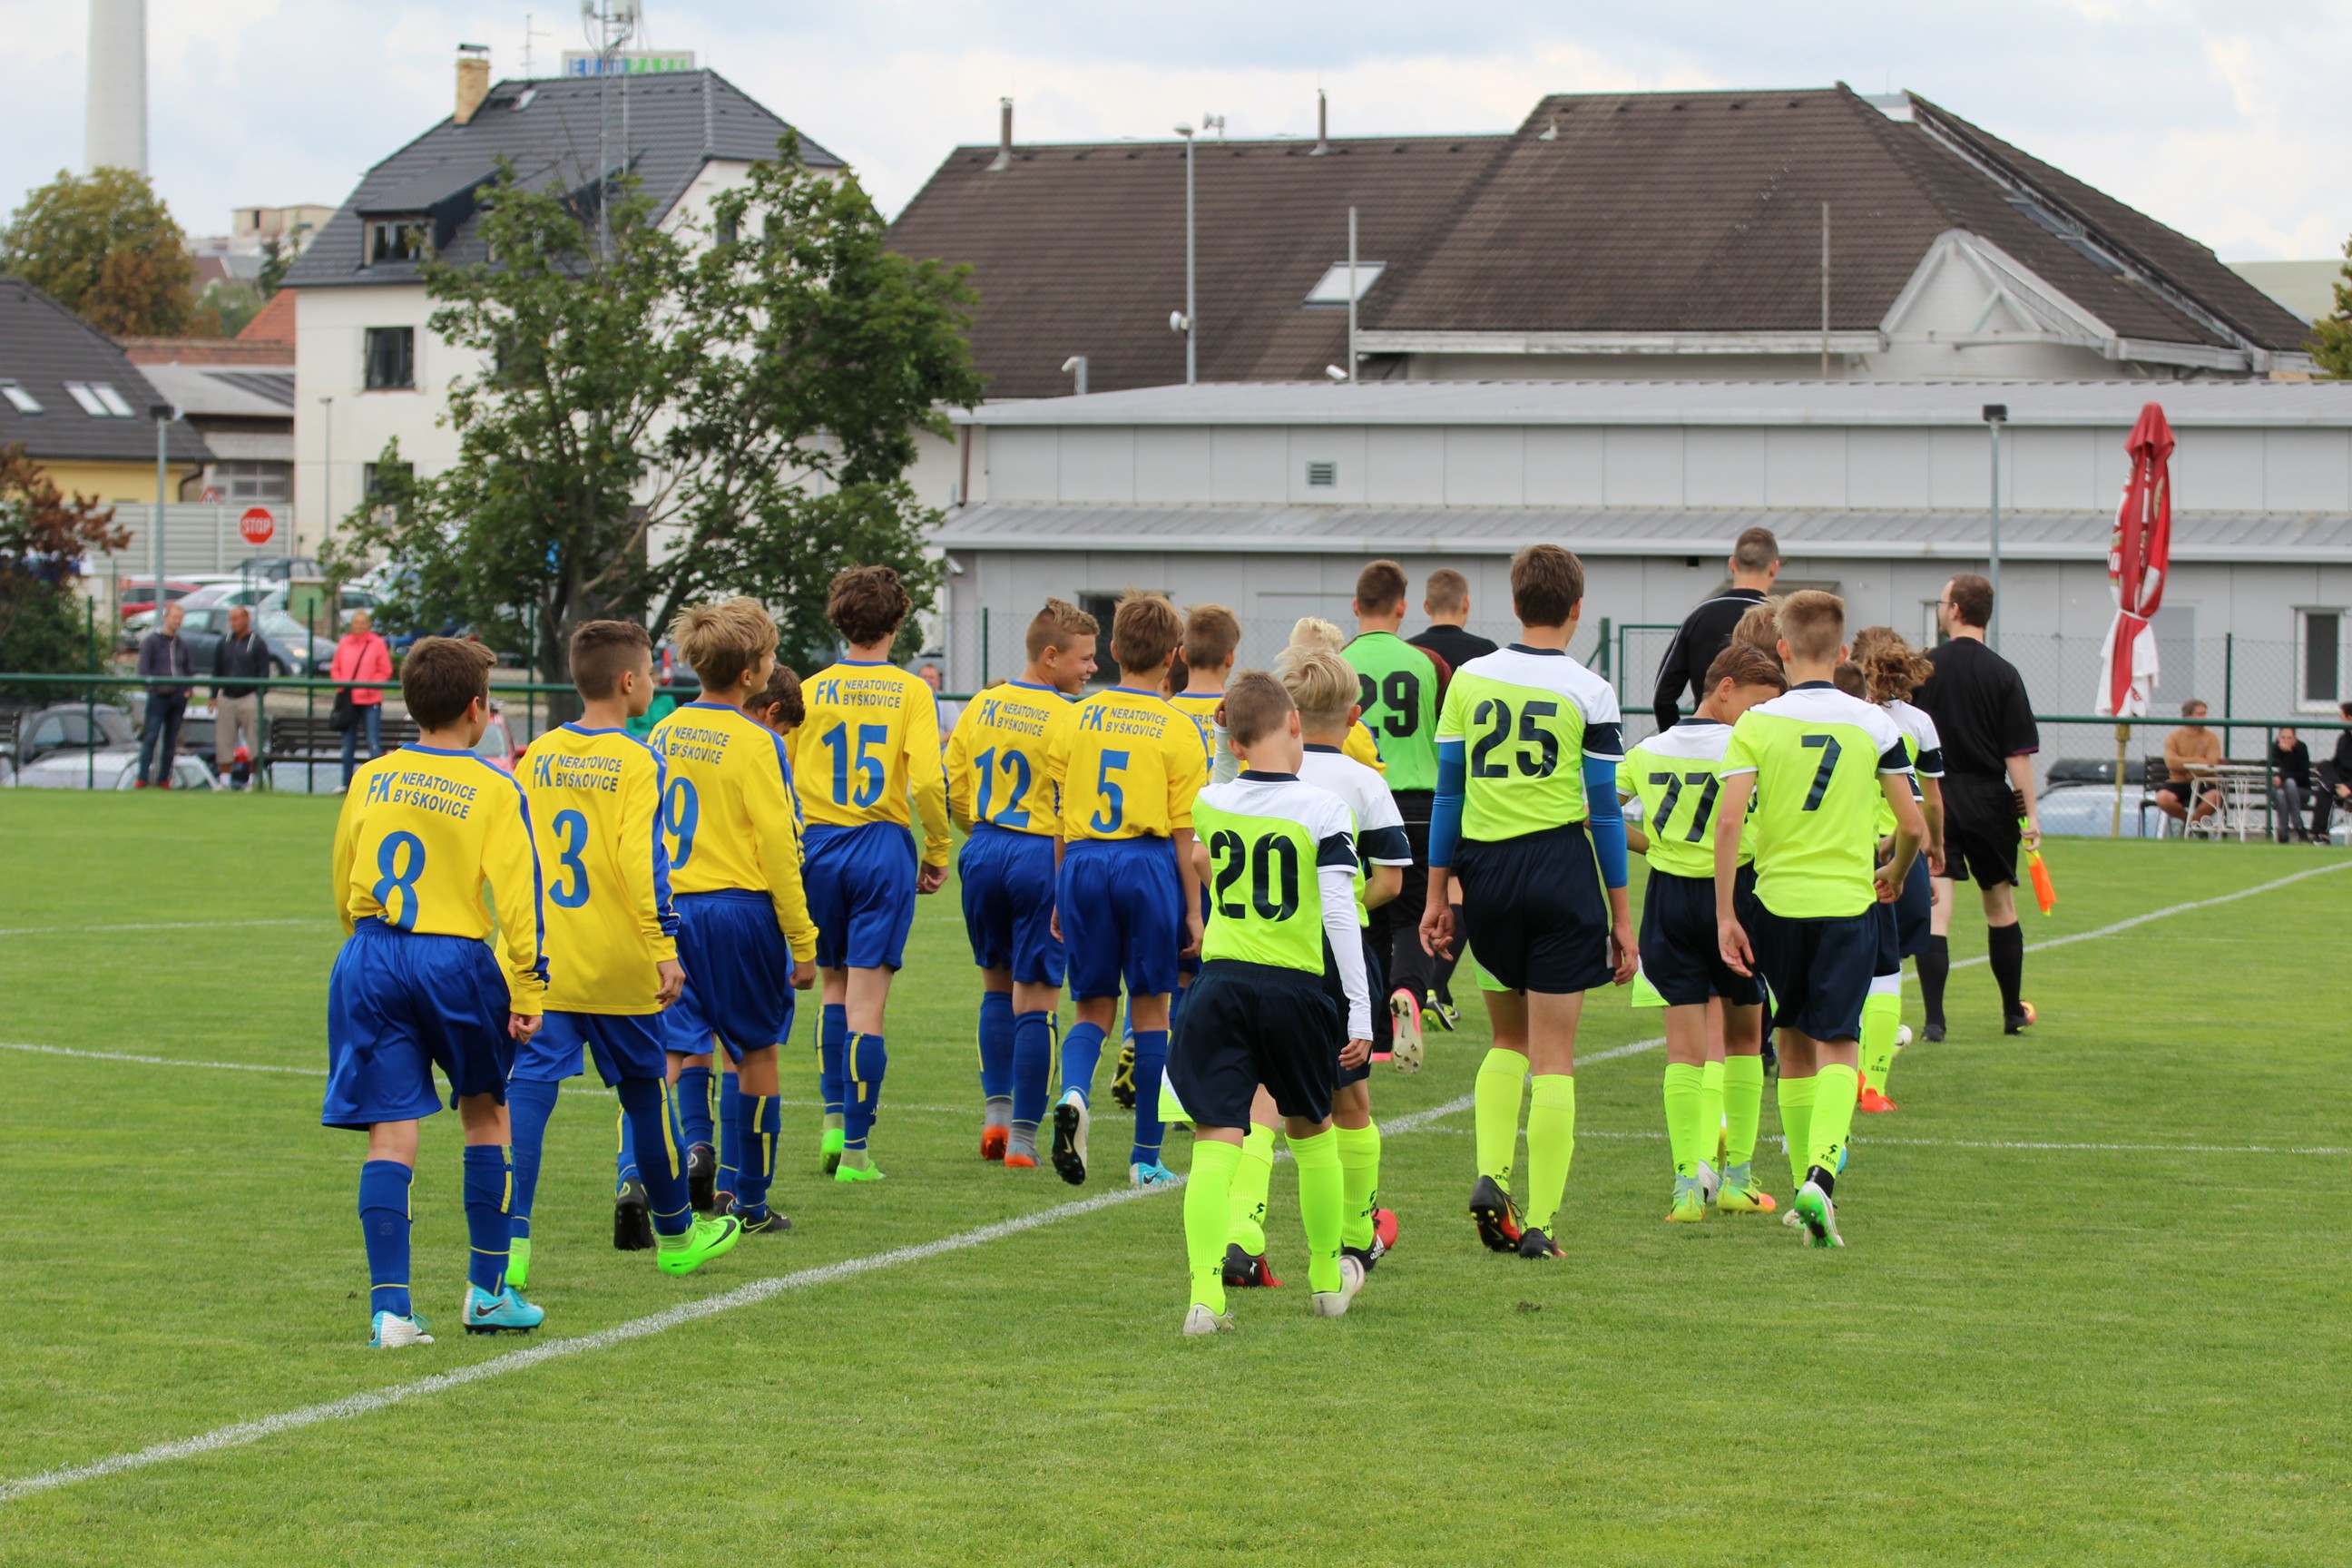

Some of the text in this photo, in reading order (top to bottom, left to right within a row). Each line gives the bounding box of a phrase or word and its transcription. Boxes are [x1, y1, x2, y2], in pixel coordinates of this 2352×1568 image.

[242, 517, 270, 534] STOP
[815, 679, 840, 705] FK
[843, 693, 901, 709] BYŠKOVICE
[844, 679, 904, 693] NERATOVICE
[977, 699, 1000, 728] FK
[1002, 702, 1051, 722] NERATOVICE
[1079, 705, 1107, 732] FK
[1110, 708, 1167, 724] NERATOVICE
[1357, 671, 1419, 739] 29
[652, 725, 672, 756] FK
[673, 727, 730, 747] NERATOVICE
[997, 717, 1044, 737] BYŠKOVICE
[1105, 721, 1163, 739] BYŠKOVICE
[1471, 699, 1558, 779] 25
[557, 754, 622, 773] NERATOVICE
[670, 743, 722, 764] BYŠKOVICE
[821, 721, 887, 808] 15
[400, 771, 477, 801] NERATOVICE
[533, 753, 555, 789] FK
[555, 770, 618, 792] BYŠKOVICE
[1801, 735, 1841, 811] 7
[365, 771, 398, 807] FK
[974, 747, 1031, 828] 12
[1090, 750, 1130, 833] 5
[393, 789, 471, 819] BYŠKOVICE
[1648, 771, 1720, 843] 77
[664, 777, 699, 869] 9
[548, 809, 589, 907] 3
[372, 831, 426, 932] 8
[1210, 829, 1298, 922] 20
